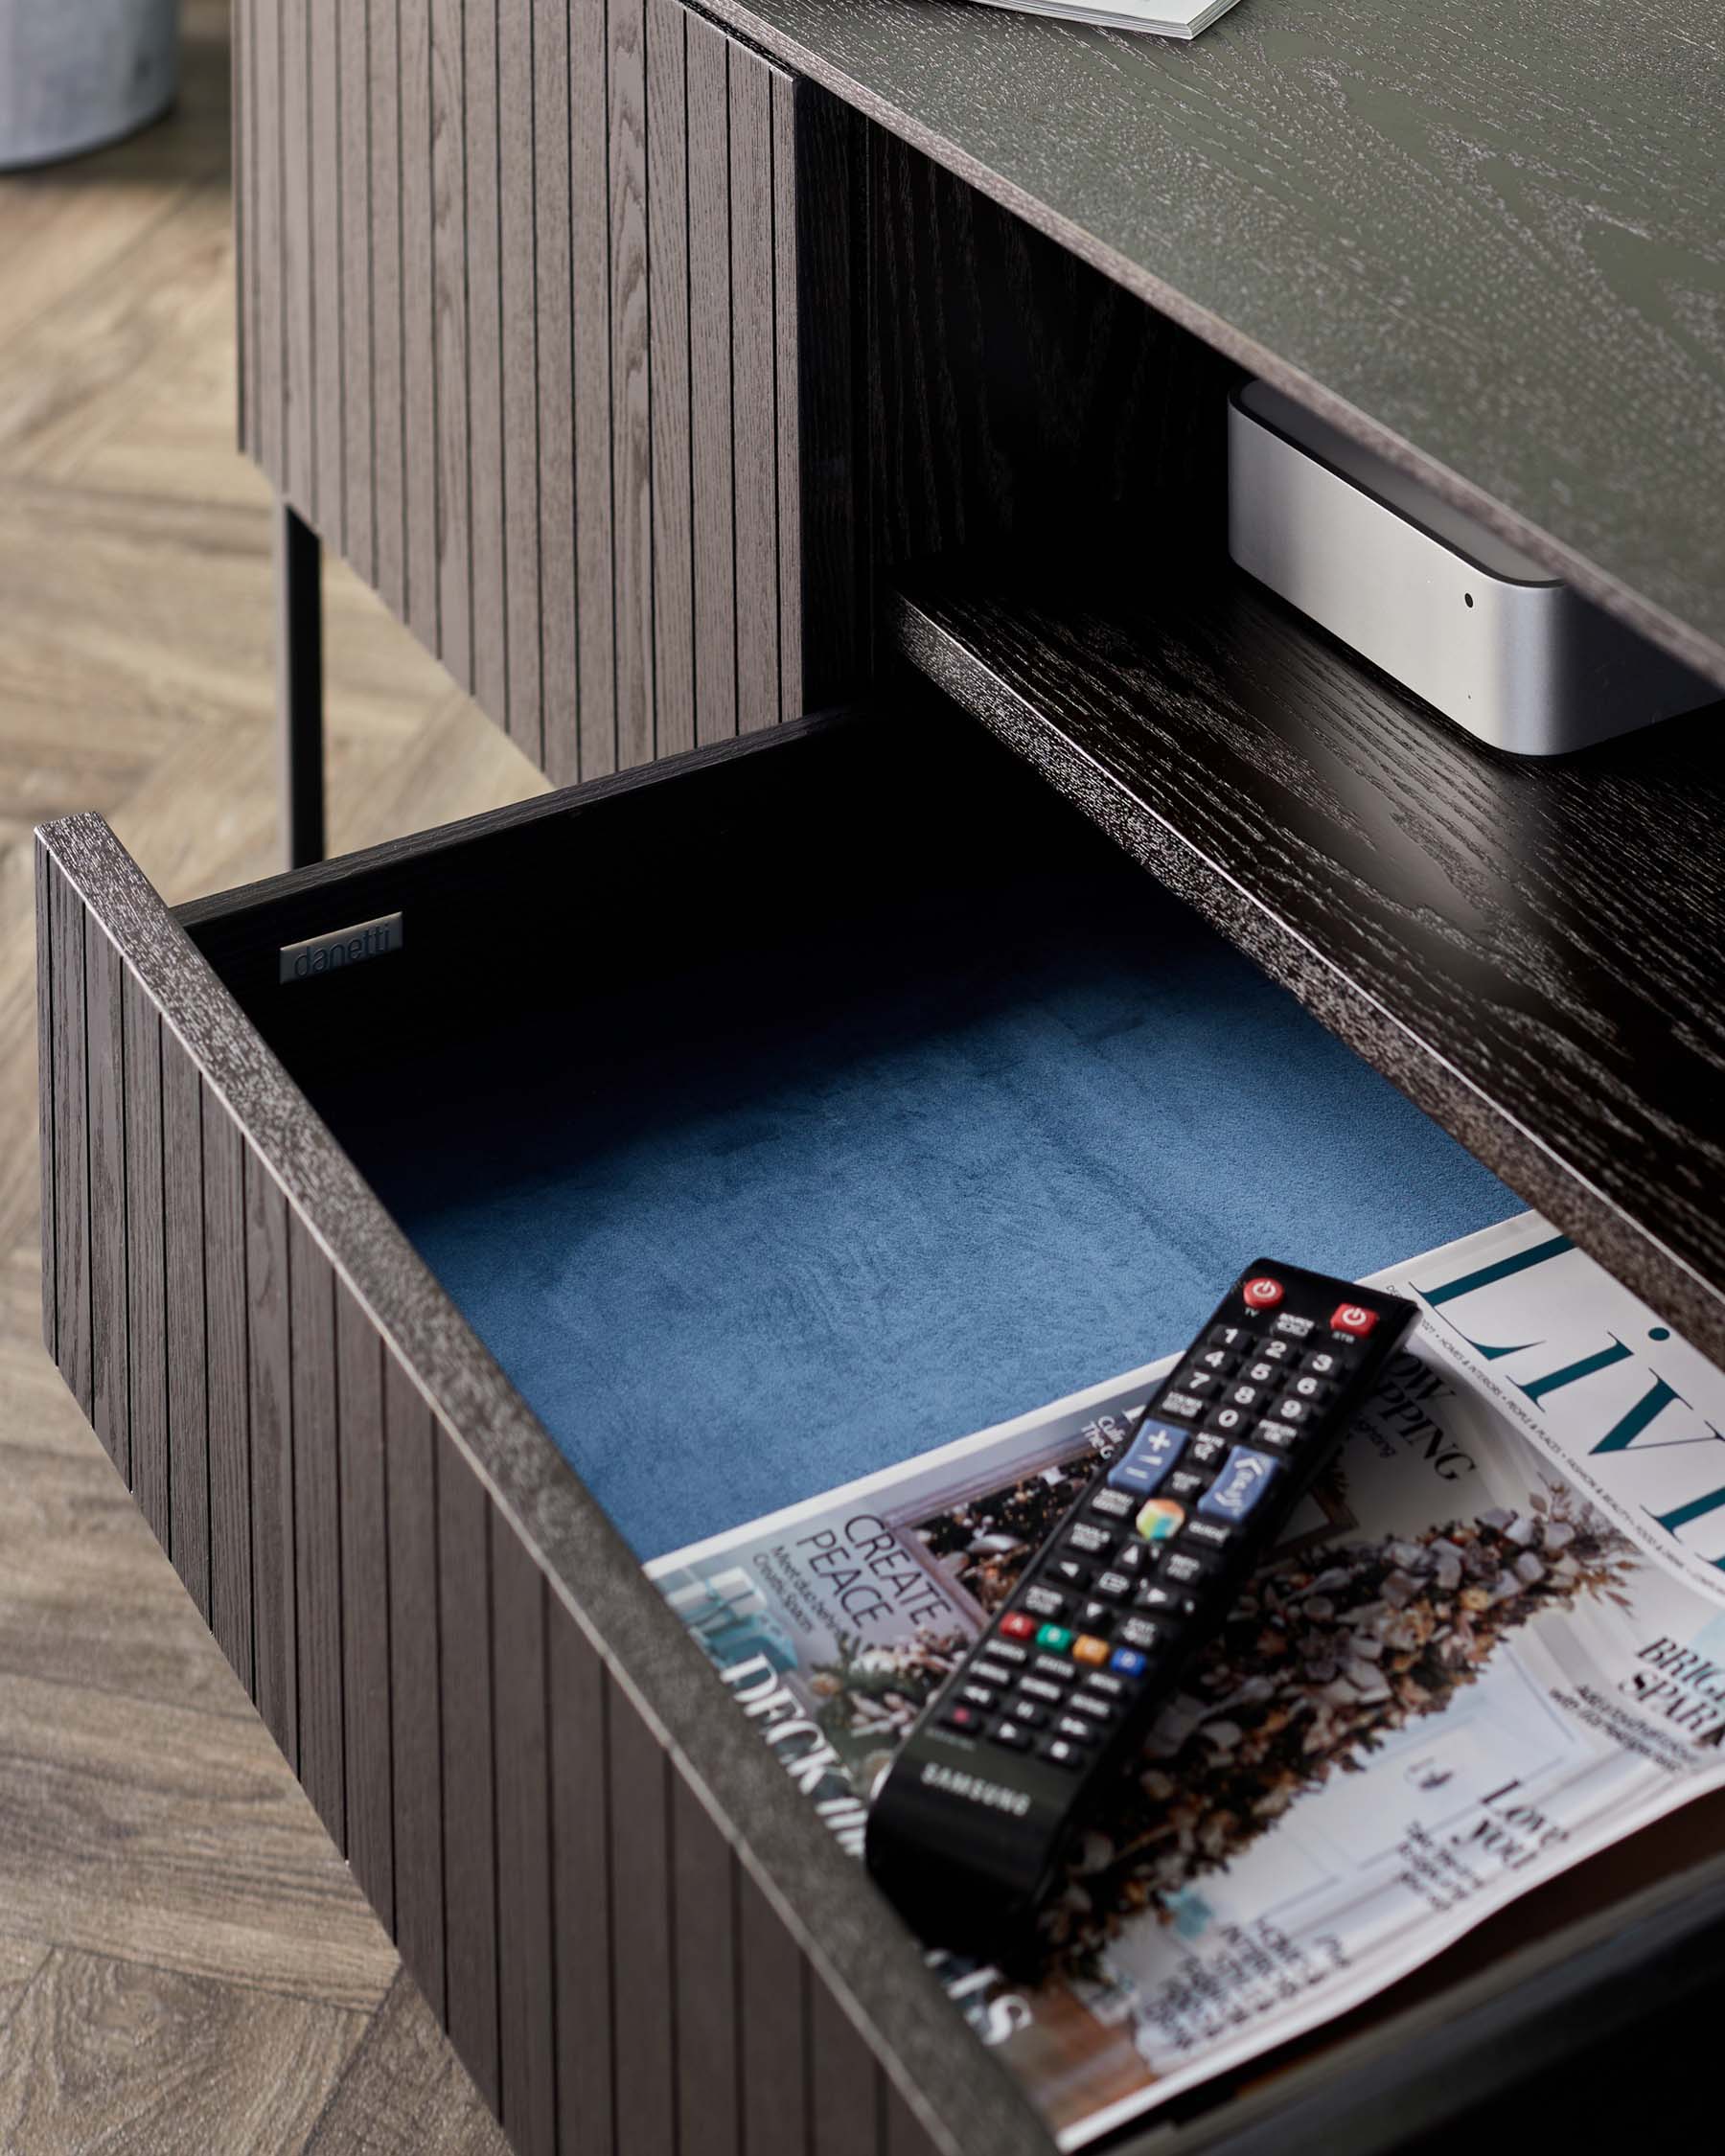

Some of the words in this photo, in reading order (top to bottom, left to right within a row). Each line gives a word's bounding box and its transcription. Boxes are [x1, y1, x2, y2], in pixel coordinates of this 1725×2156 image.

[294, 922, 390, 977] danetti
[1245, 1307, 1259, 1318] TV
[1225, 1329, 1238, 1343] 1
[1205, 1351, 1224, 1367] 4
[1265, 1342, 1287, 1359] 2
[1312, 1354, 1333, 1371] 3
[1189, 1371, 1210, 1388] 7
[1251, 1363, 1272, 1380] 5
[1297, 1377, 1318, 1394] 6
[1234, 1386, 1255, 1404] 8
[1280, 1400, 1301, 1418] 9
[1218, 1410, 1239, 1427] 0
[1375, 1381, 1477, 1480] PPING
[844, 1515, 953, 1625] CREATE
[796, 1529, 894, 1629] PEACE
[1637, 1637, 1725, 1702] BRIG
[720, 1653, 852, 1796] DECK
[921, 1762, 1032, 1817] SAMSUNG
